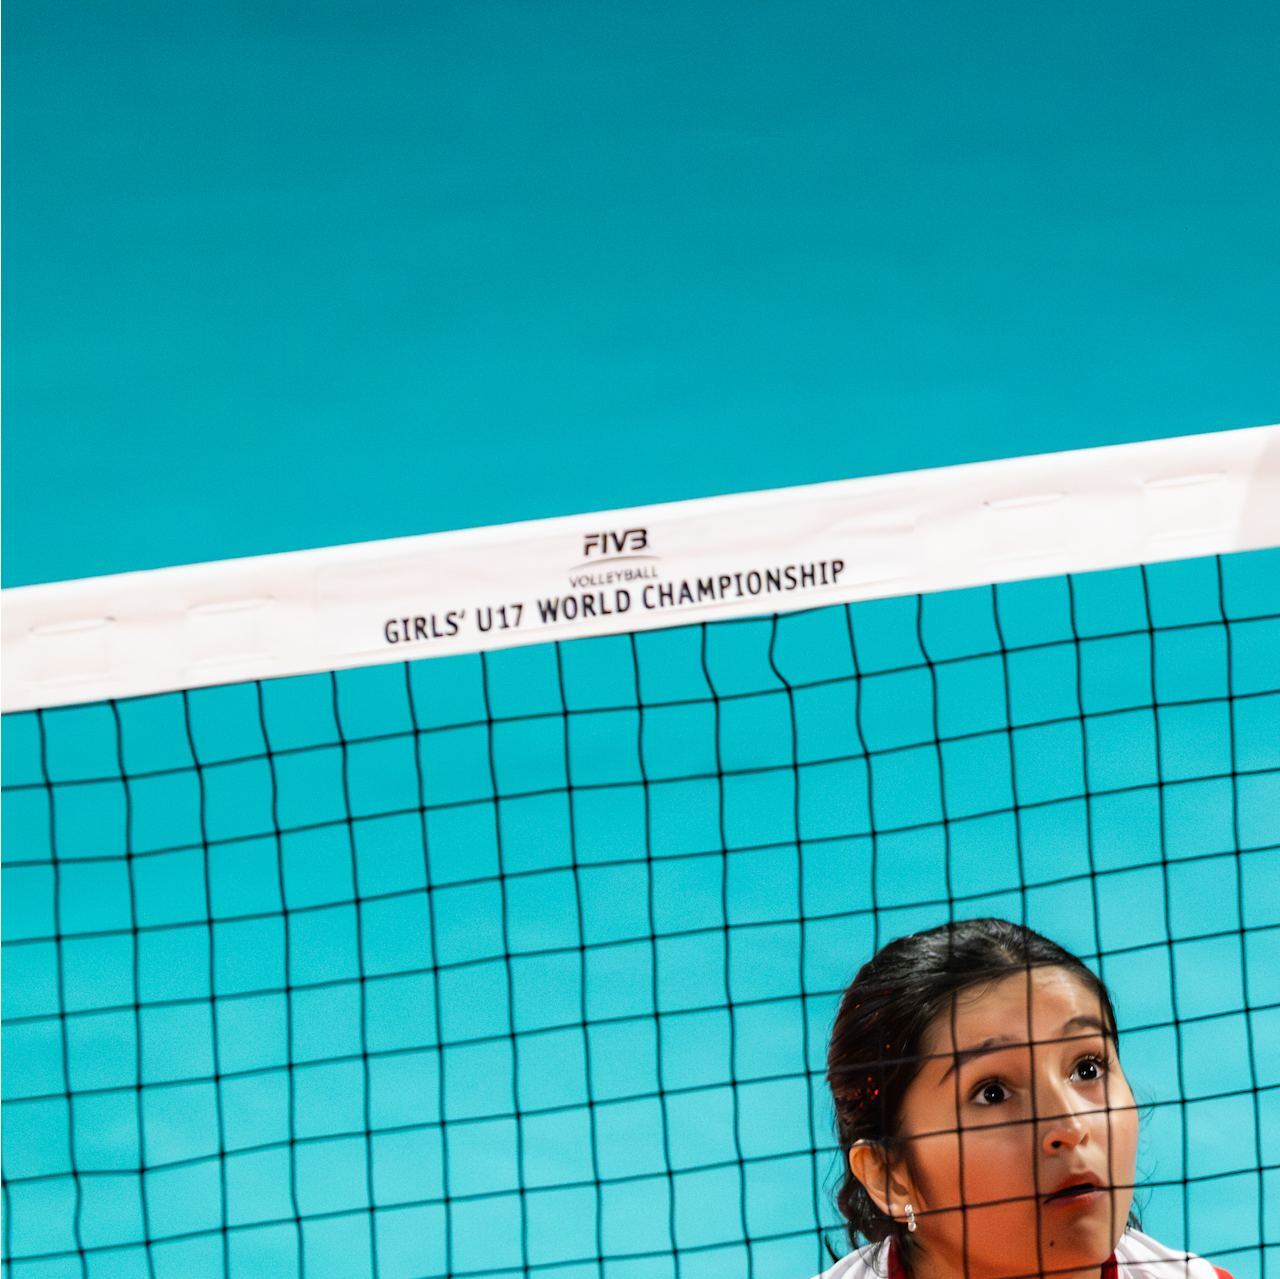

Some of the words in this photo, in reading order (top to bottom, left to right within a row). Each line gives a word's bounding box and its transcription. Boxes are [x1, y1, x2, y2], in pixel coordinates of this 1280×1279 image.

[584, 527, 648, 556] FIVB
[568, 565, 659, 589] VOLLEYBALL
[476, 604, 524, 633] U17
[537, 588, 631, 625] WORLD
[642, 558, 846, 610] CHAMPIONSHIP
